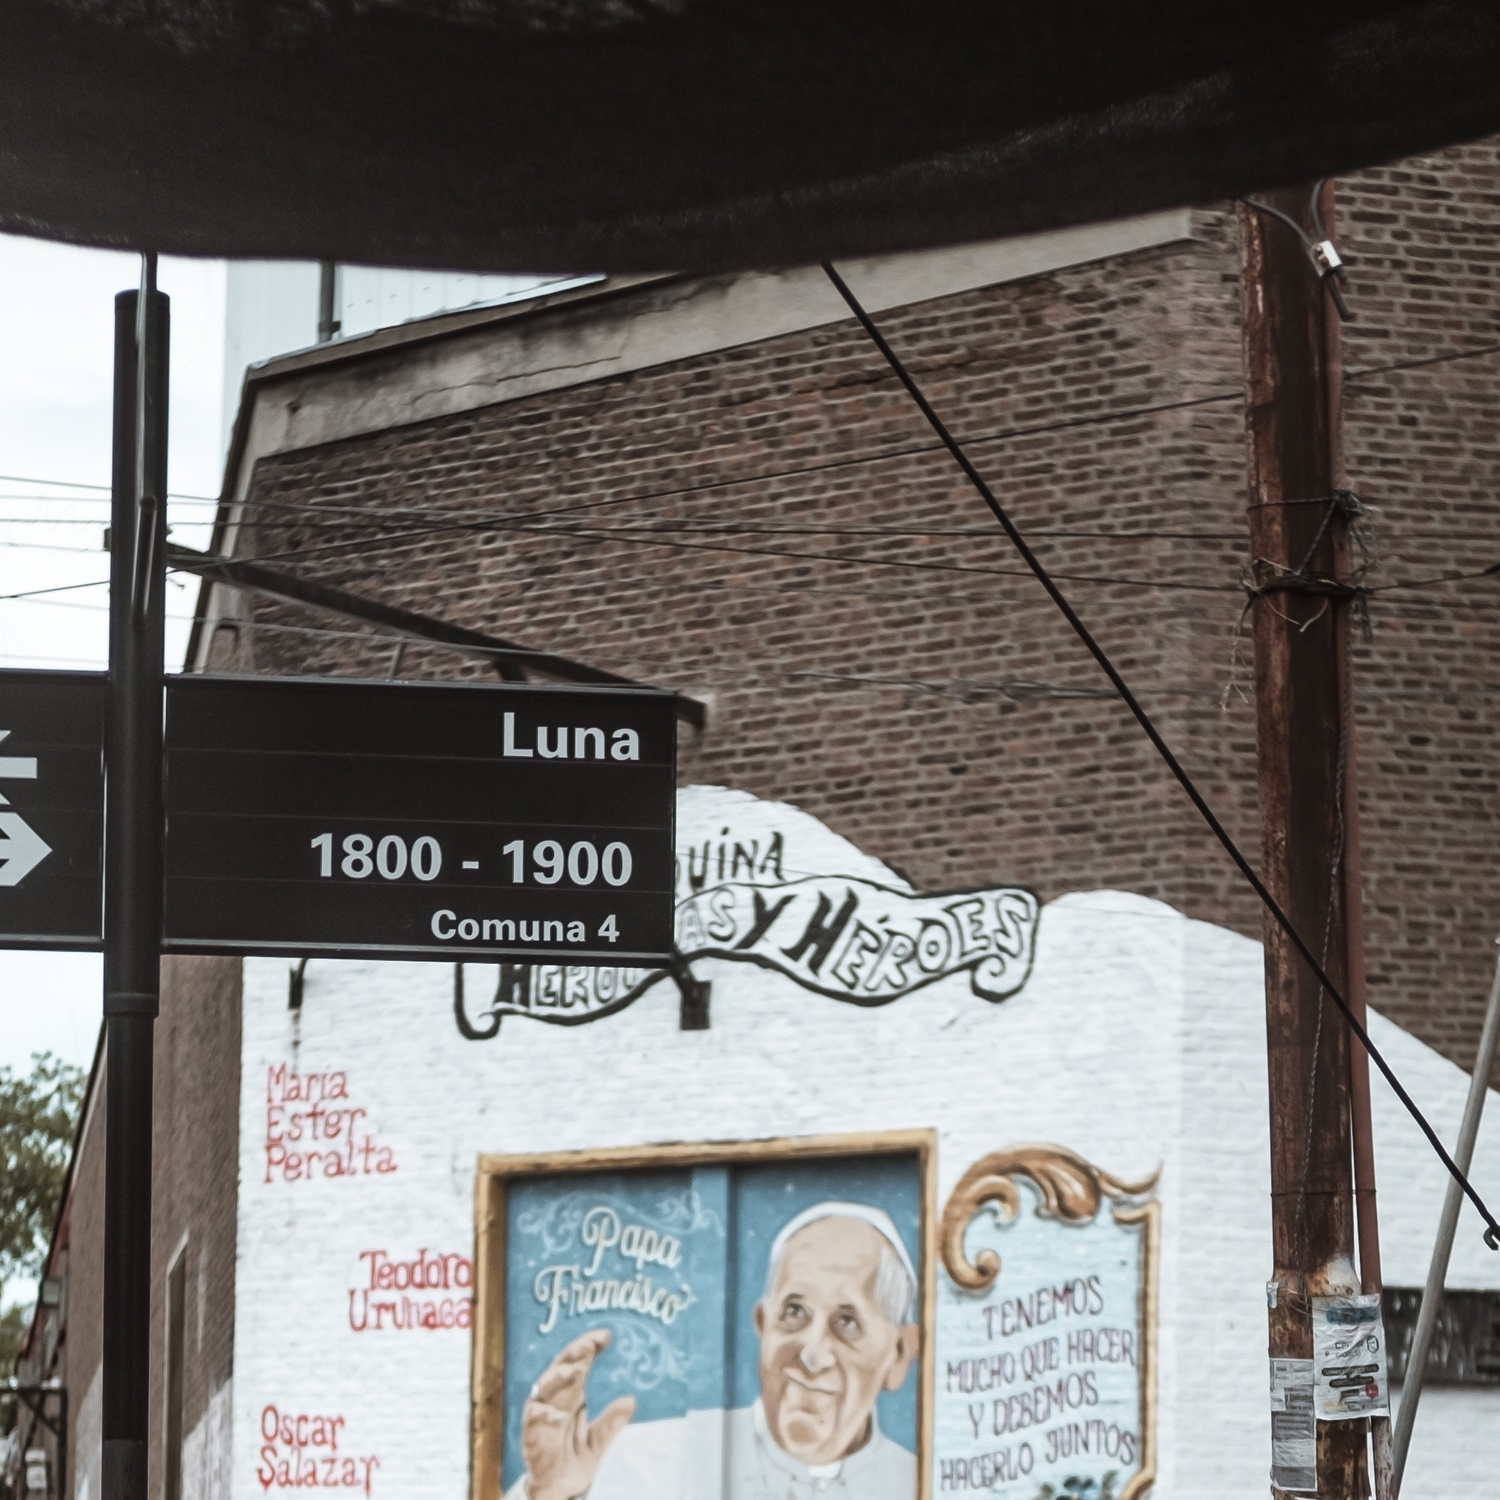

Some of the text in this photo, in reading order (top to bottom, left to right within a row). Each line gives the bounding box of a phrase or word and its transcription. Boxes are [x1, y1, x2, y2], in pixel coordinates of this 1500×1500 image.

[502, 711, 641, 761] Luna
[310, 832, 443, 881] 1800
[501, 839, 633, 886] 1900
[431, 909, 620, 943] Comuna 4
[732, 889, 799, 950] Y
[267, 1101, 367, 1143] Ester
[264, 1134, 398, 1184] Peralta
[359, 1247, 472, 1291] Teodoro
[582, 1206, 683, 1277] Papa
[534, 1264, 699, 1335] Francisco
[982, 1274, 1104, 1341] TENEMOS
[946, 1327, 1136, 1394] MUCHO QUE HACER
[261, 1404, 345, 1450] Oscar
[967, 1370, 1099, 1440] Y DEBEMOS
[256, 1444, 381, 1500] Salazar
[940, 1419, 1136, 1492] HACERLO JUNTOS
